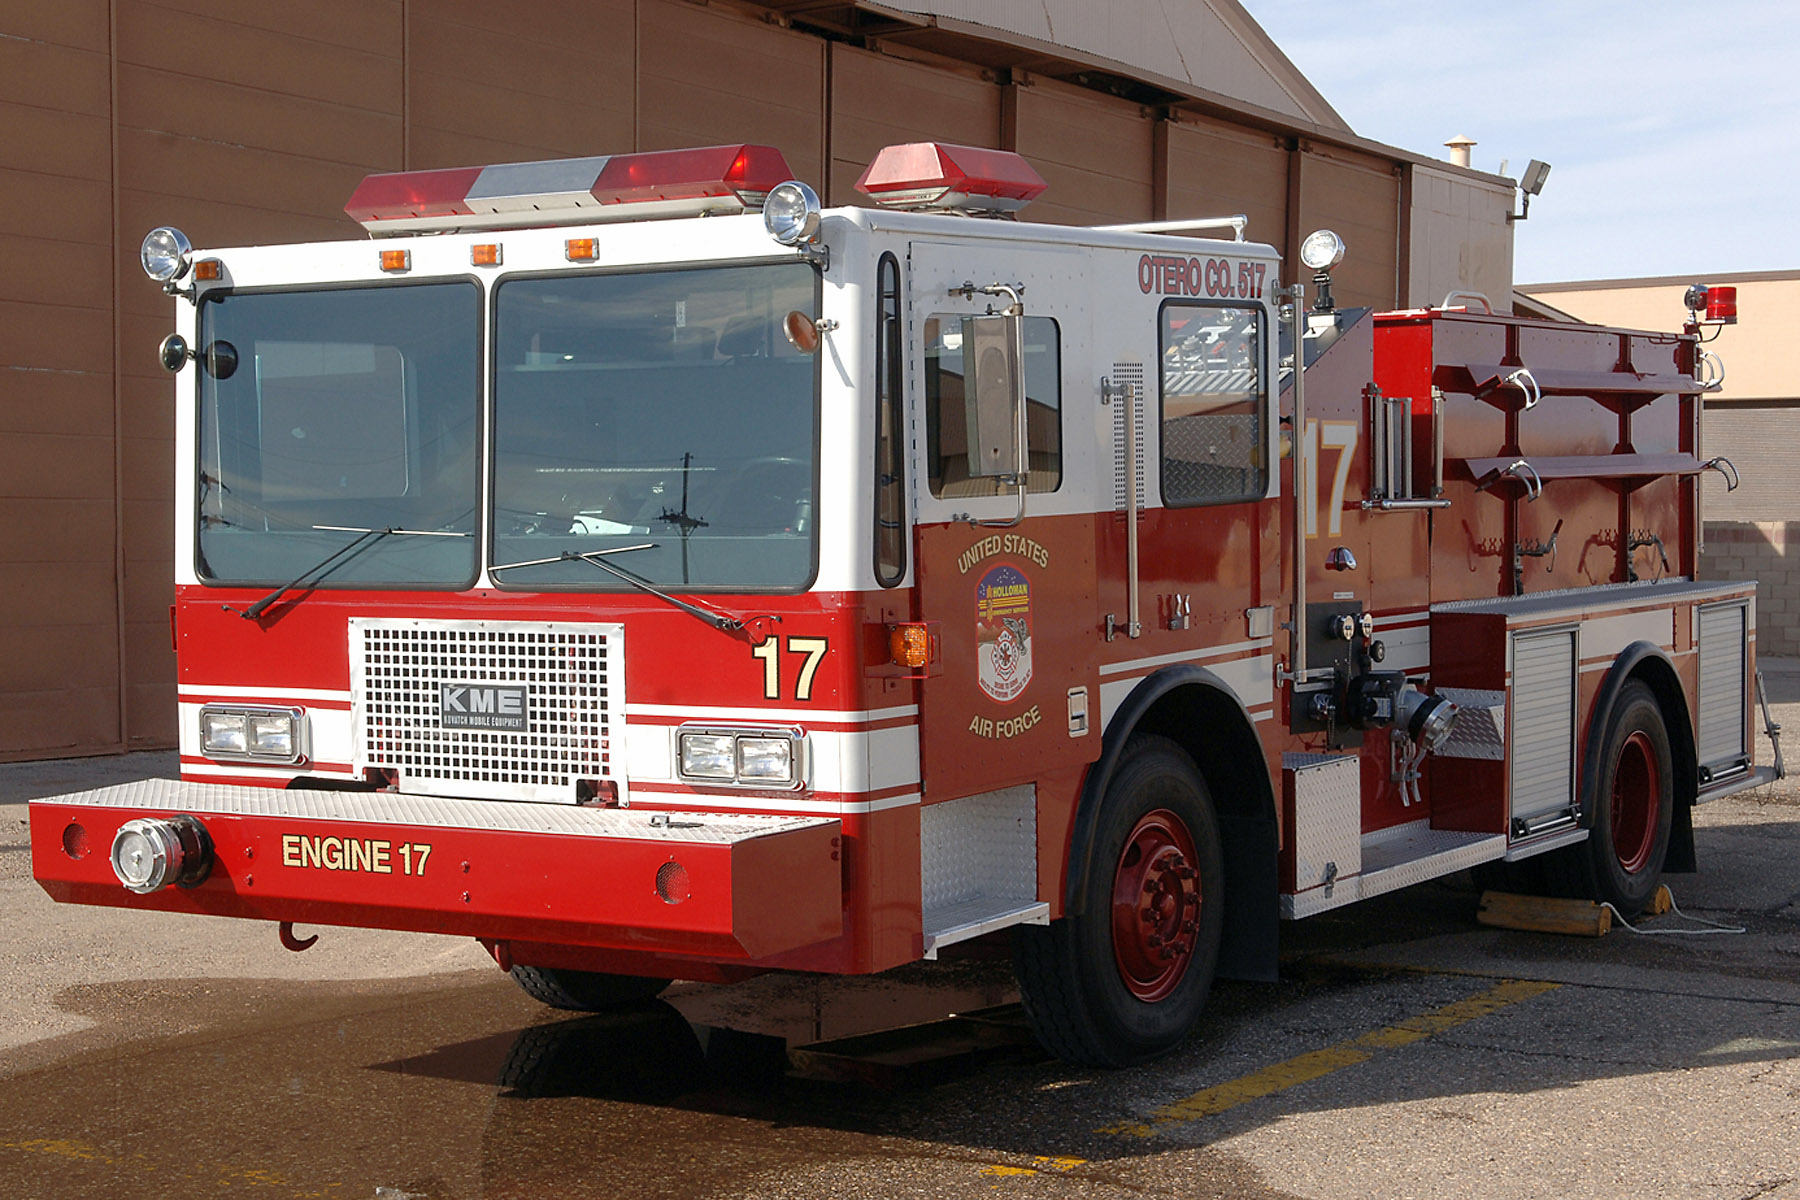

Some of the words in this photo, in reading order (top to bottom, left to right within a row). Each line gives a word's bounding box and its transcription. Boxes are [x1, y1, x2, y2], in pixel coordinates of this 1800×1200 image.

[1138, 254, 1202, 296] OTERO
[1205, 258, 1236, 298] CO.
[1237, 262, 1267, 299] 517
[1302, 417, 1359, 539] 17
[957, 534, 1001, 574] UNITED
[1003, 533, 1049, 569] STATES
[992, 583, 1028, 598] HOLLOMAN
[751, 633, 830, 702] 17
[442, 687, 523, 715] KME
[469, 715, 490, 727] MOBILE
[491, 716, 523, 728] EQUIPMENT
[968, 714, 993, 739] AIR
[995, 704, 1042, 740] FORCE
[281, 833, 393, 874] ENGINE
[397, 841, 433, 876] 17
